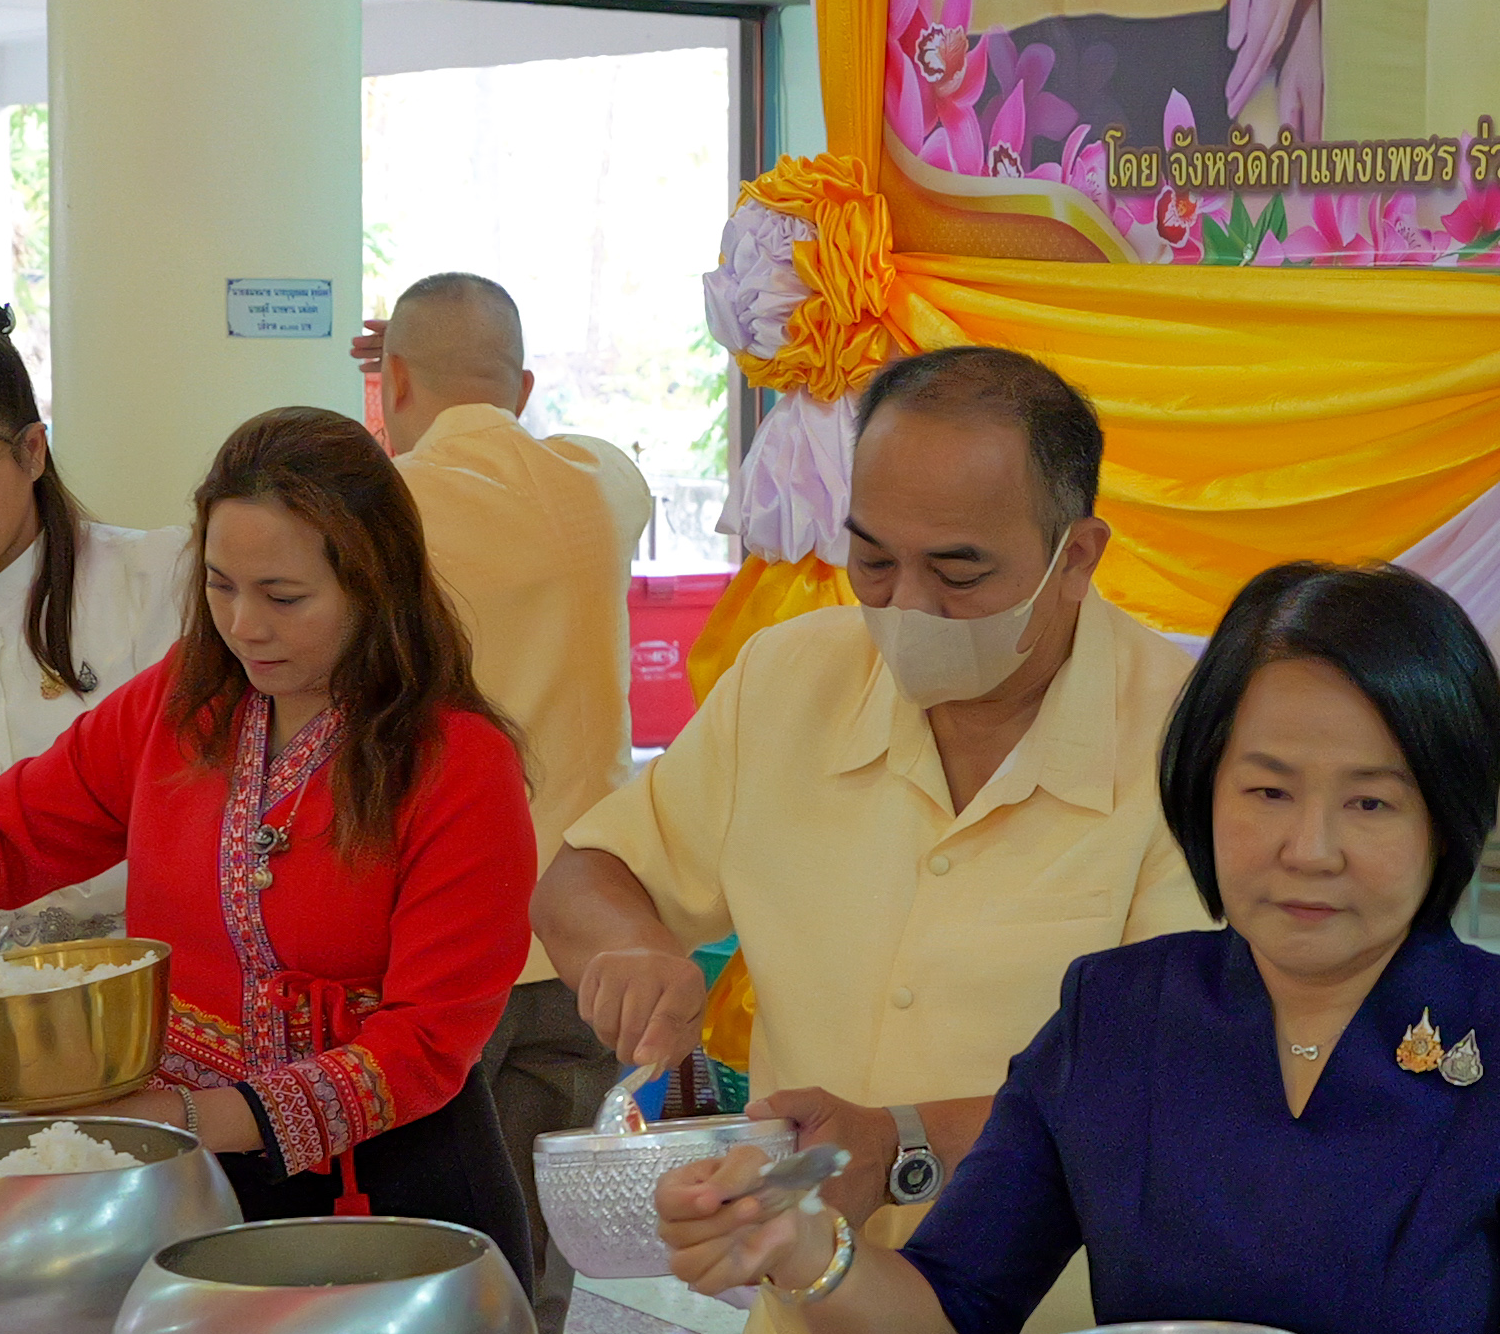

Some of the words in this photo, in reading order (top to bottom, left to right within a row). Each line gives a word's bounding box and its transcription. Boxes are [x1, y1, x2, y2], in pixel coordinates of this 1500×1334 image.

[1104, 129, 1160, 188] โดย
[1169, 129, 1457, 188] จังหวัดกำแพงเพชร
